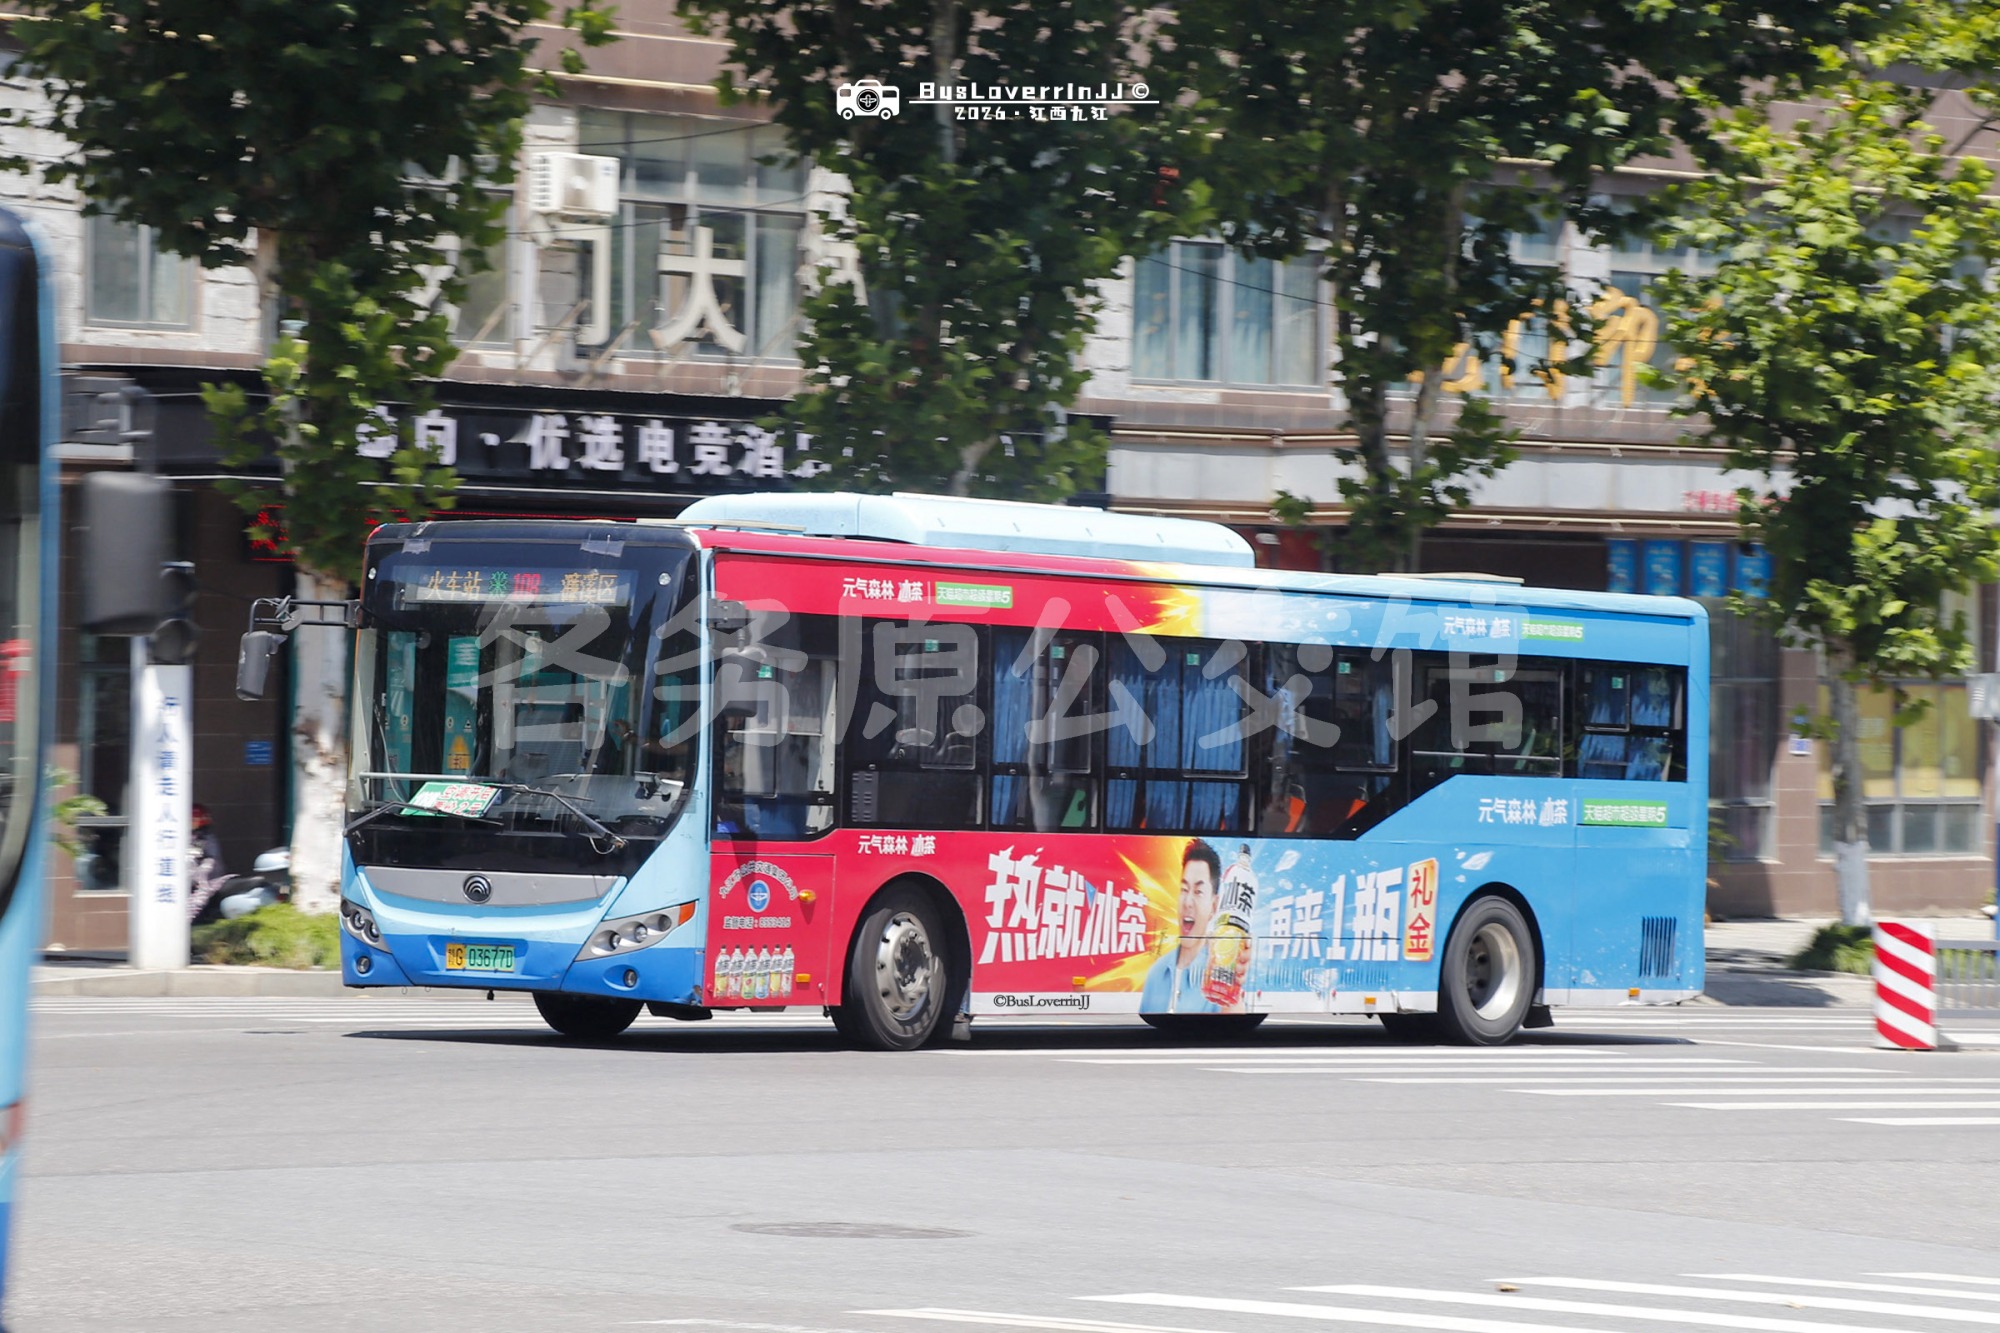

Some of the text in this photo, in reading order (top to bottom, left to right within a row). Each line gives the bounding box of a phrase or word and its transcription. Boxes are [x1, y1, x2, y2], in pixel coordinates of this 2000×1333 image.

[427, 570, 482, 600] 火车站
[513, 573, 541, 601] 108
[842, 577, 895, 600] 元气森林
[1444, 616, 1487, 637] 元气森林
[1478, 797, 1537, 824] 元气森林
[858, 834, 908, 855] 元气森林
[977, 845, 1149, 965] 热就冰茶
[1268, 867, 1403, 962] 再来1瓶
[1407, 867, 1433, 954] 礼金
